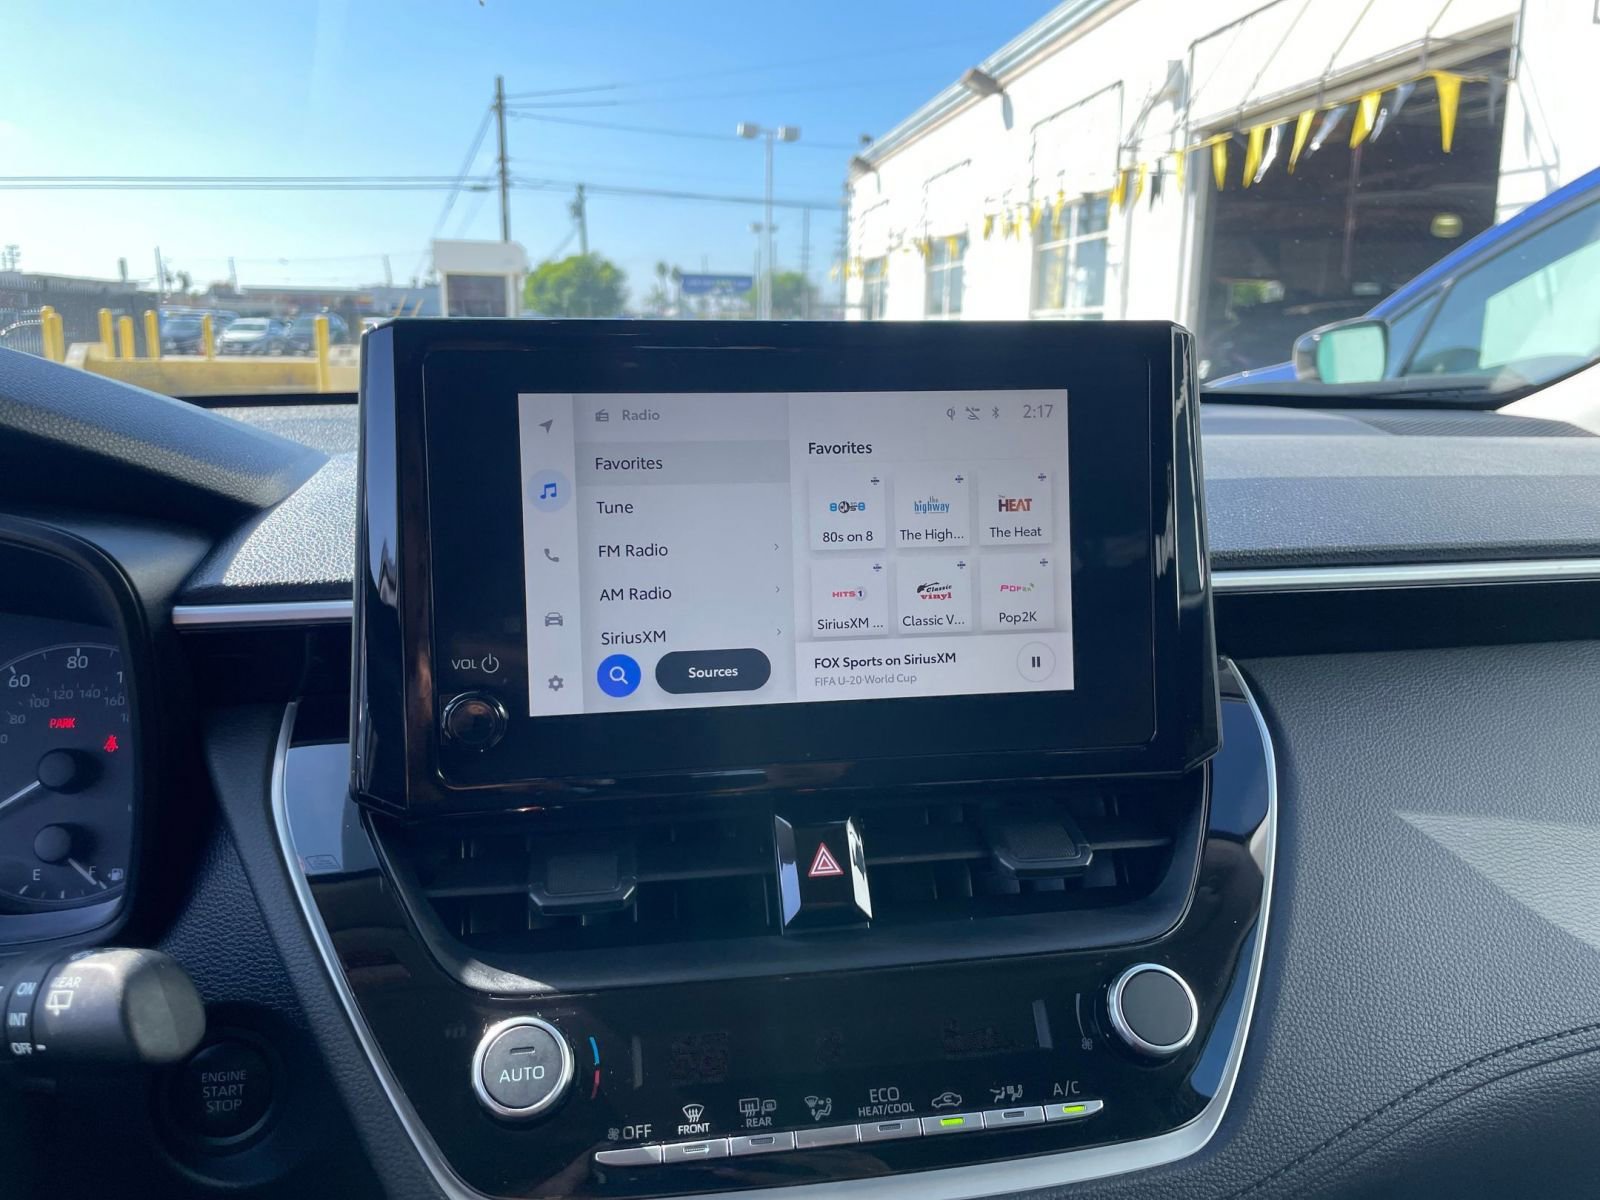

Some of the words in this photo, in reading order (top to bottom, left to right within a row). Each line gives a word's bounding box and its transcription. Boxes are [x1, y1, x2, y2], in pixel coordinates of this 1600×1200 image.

[622, 409, 661, 421] Radio
[1023, 404, 1053, 419] 2:17
[808, 441, 873, 455] Favorites
[595, 456, 663, 470] Favorites
[596, 501, 634, 514] Tune
[914, 500, 950, 514] highway
[998, 498, 1033, 512] HEAT
[822, 531, 844, 542] 80s
[847, 533, 863, 542] on
[866, 530, 874, 541] 8
[900, 529, 922, 540] The
[989, 527, 1011, 538] The
[1014, 526, 1042, 537] Heat
[598, 544, 621, 558] FM
[625, 543, 669, 557] Radio
[600, 588, 624, 601] AM
[629, 587, 672, 600] Radio
[832, 590, 856, 598] HITS
[857, 589, 864, 598] 1
[926, 584, 953, 593] Classic
[920, 591, 952, 601] vinyl
[817, 617, 869, 631] SiriusXM
[902, 615, 943, 627] Classic
[999, 611, 1037, 625] Pop2K
[601, 630, 666, 645] SiriusXM
[66, 655, 88, 669] 80
[451, 659, 477, 670] VOL
[814, 657, 840, 669] FOX
[843, 656, 882, 670] Sports
[885, 658, 901, 667] on
[904, 653, 956, 665] SiriusXM
[688, 666, 738, 679] Sources
[8, 674, 30, 688] 60
[815, 677, 835, 687] FIFA
[838, 675, 862, 686] U-20
[864, 674, 894, 684] World
[897, 674, 917, 685] Cup
[53, 690, 74, 700] 120
[79, 688, 101, 699] 140
[29, 698, 50, 708] 100
[104, 695, 125, 707] 160
[9, 714, 26, 725] 80
[49, 717, 76, 729] PARK
[32, 868, 41, 881] E
[16, 982, 37, 995] ON
[8, 1012, 28, 1026] INT
[10, 1042, 33, 1055] OFF
[201, 1070, 248, 1083] ENGINE
[499, 1065, 545, 1083] AUTO
[202, 1084, 245, 1098] START
[869, 1086, 900, 1103] ECO
[1053, 1080, 1081, 1097] A/C
[206, 1099, 243, 1113] STOP
[858, 1101, 915, 1118] HEAT/COOL
[746, 1116, 773, 1128] REAR
[622, 1124, 652, 1140] OFF
[677, 1122, 710, 1136] FRONT
